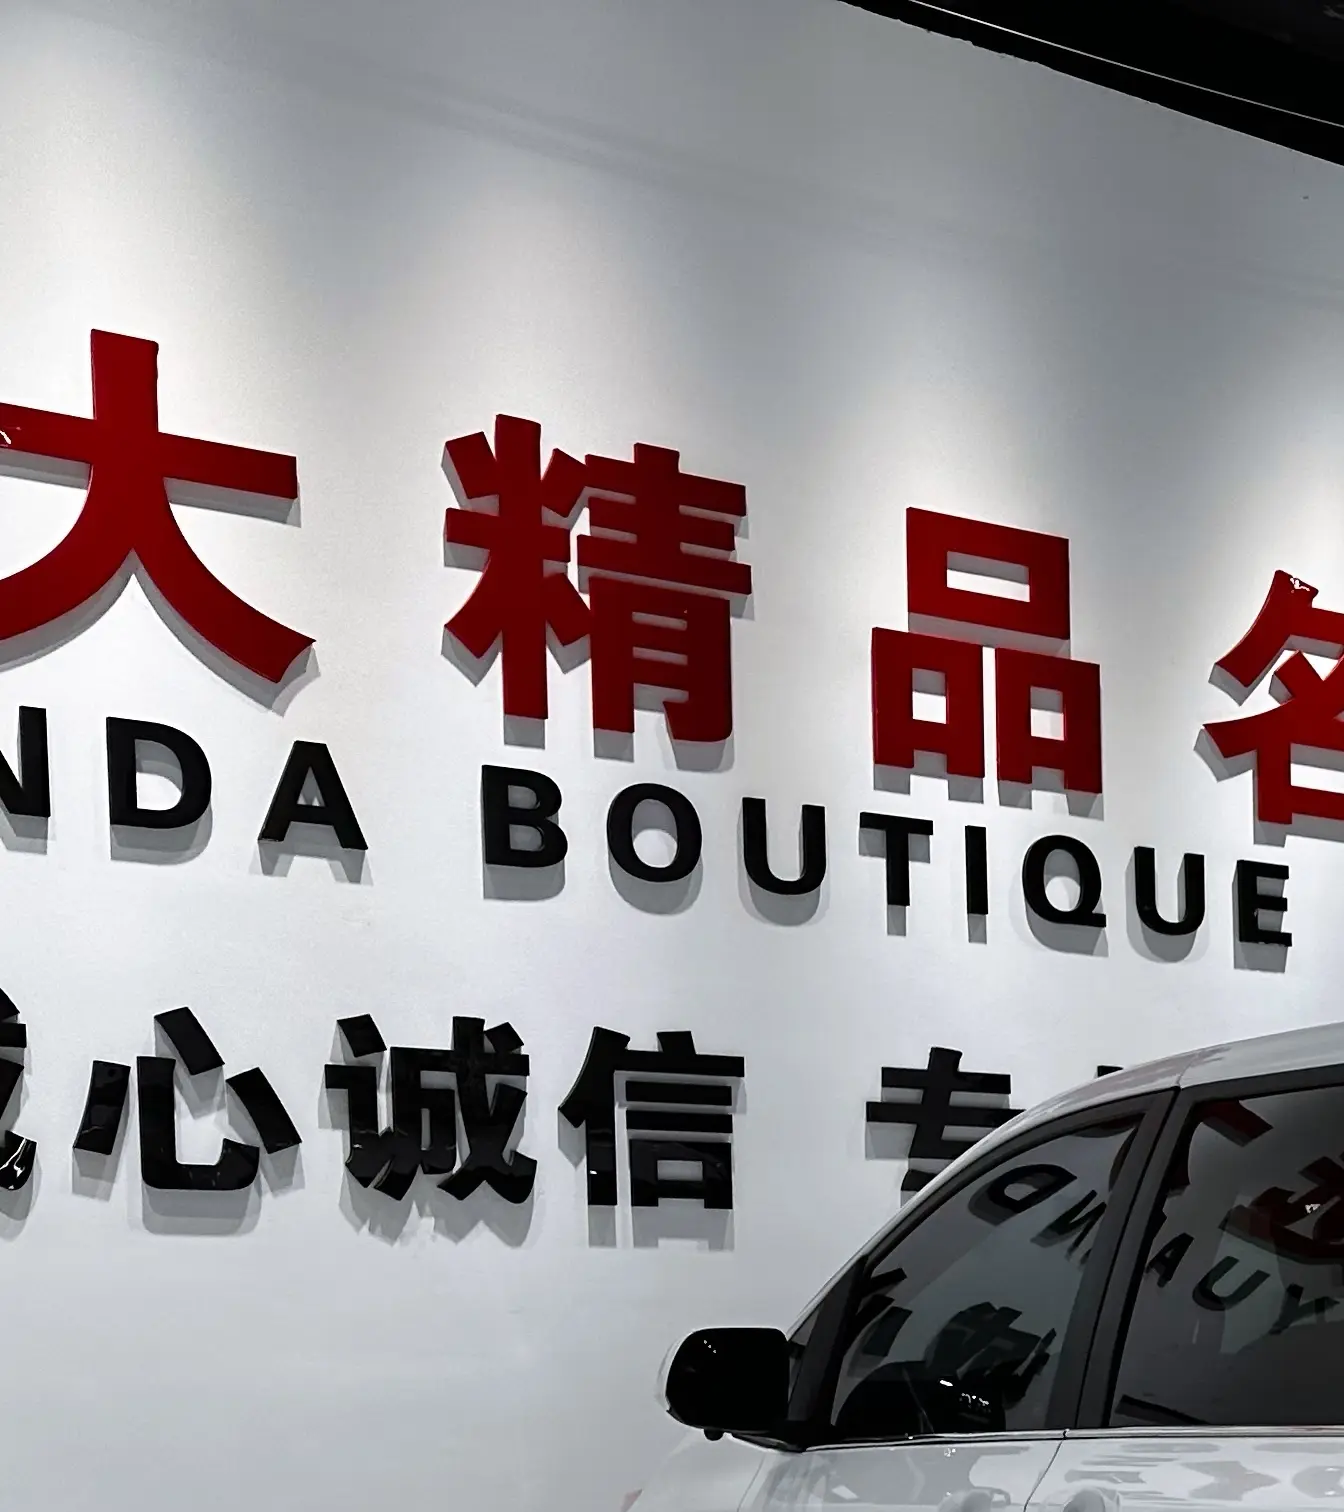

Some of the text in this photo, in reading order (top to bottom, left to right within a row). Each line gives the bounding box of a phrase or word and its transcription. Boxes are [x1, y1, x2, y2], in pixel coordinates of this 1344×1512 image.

[482, 764, 1293, 948] BOUTIQUE
[0, 988, 746, 1210] 心诚信
